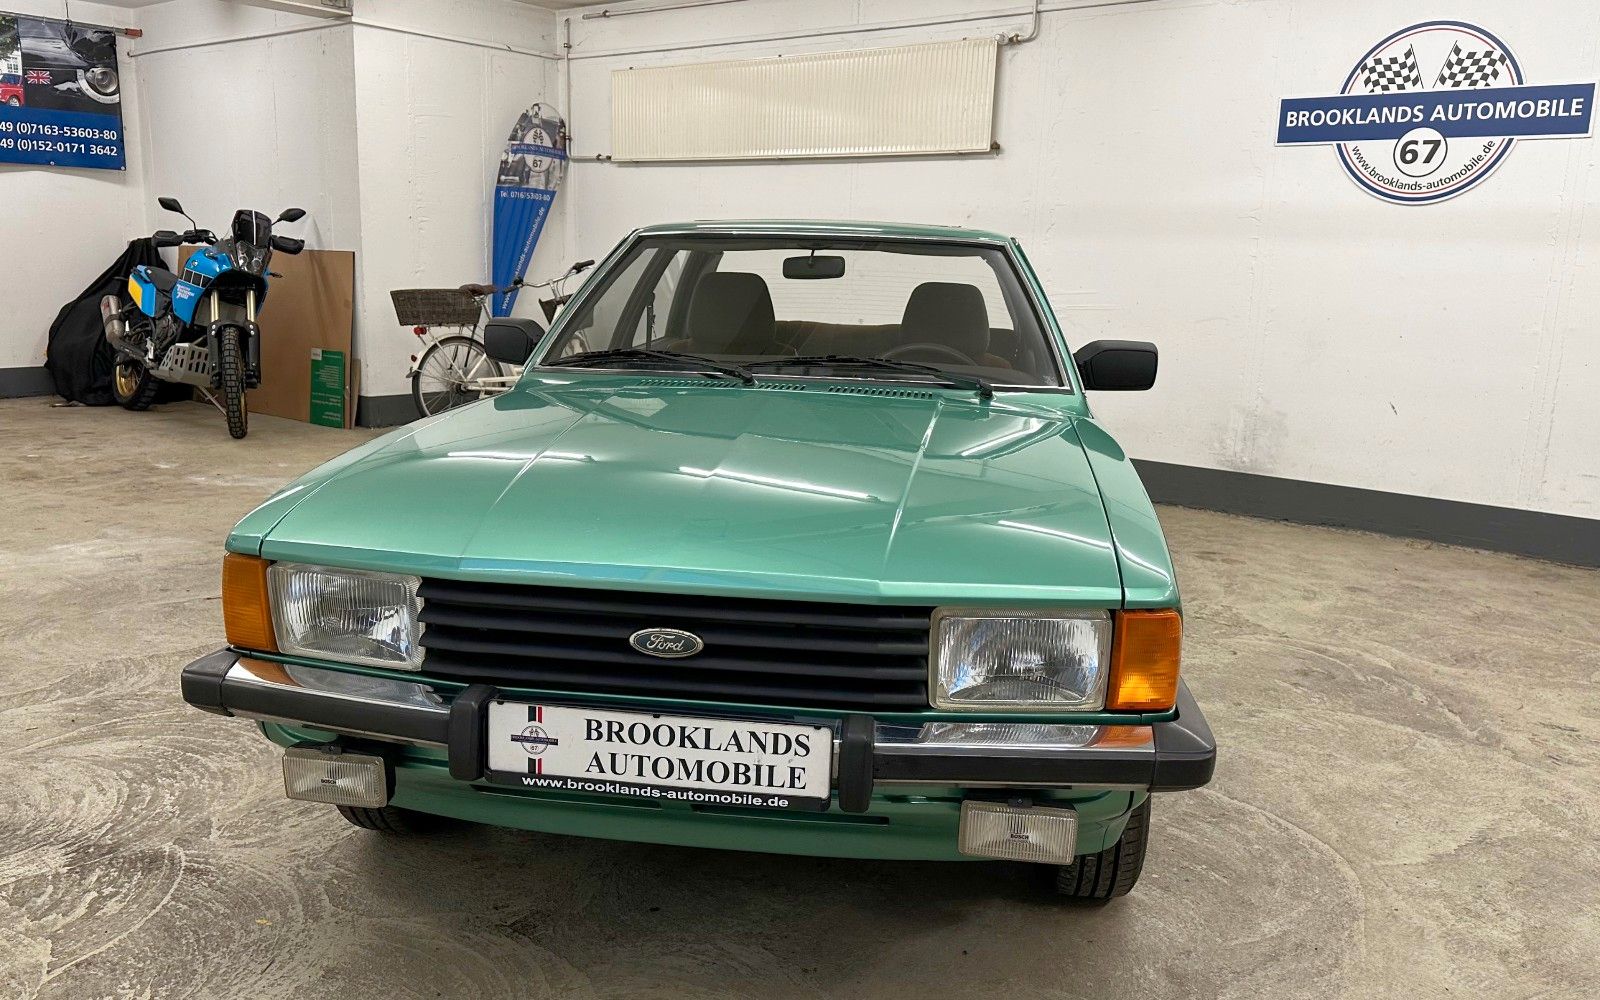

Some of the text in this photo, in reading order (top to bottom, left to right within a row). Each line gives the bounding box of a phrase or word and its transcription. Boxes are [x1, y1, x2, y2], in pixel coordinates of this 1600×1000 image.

[1286, 98, 1584, 128] BROOKLANDS AUTOMOBILE
[16, 122, 117, 140] (0)7163-53603-80
[17, 139, 85, 154] (0)152-0171
[90, 145, 118, 156] 3642
[1399, 139, 1442, 165] 67
[532, 159, 543, 168] 67
[1351, 139, 1496, 191] www.brooklands-automobile.de
[646, 633, 684, 651] Ford
[584, 718, 811, 757] BROOKLANDS
[585, 751, 807, 790] AUTOMOBILE
[521, 776, 789, 808] www.brooklands-automobile.de
